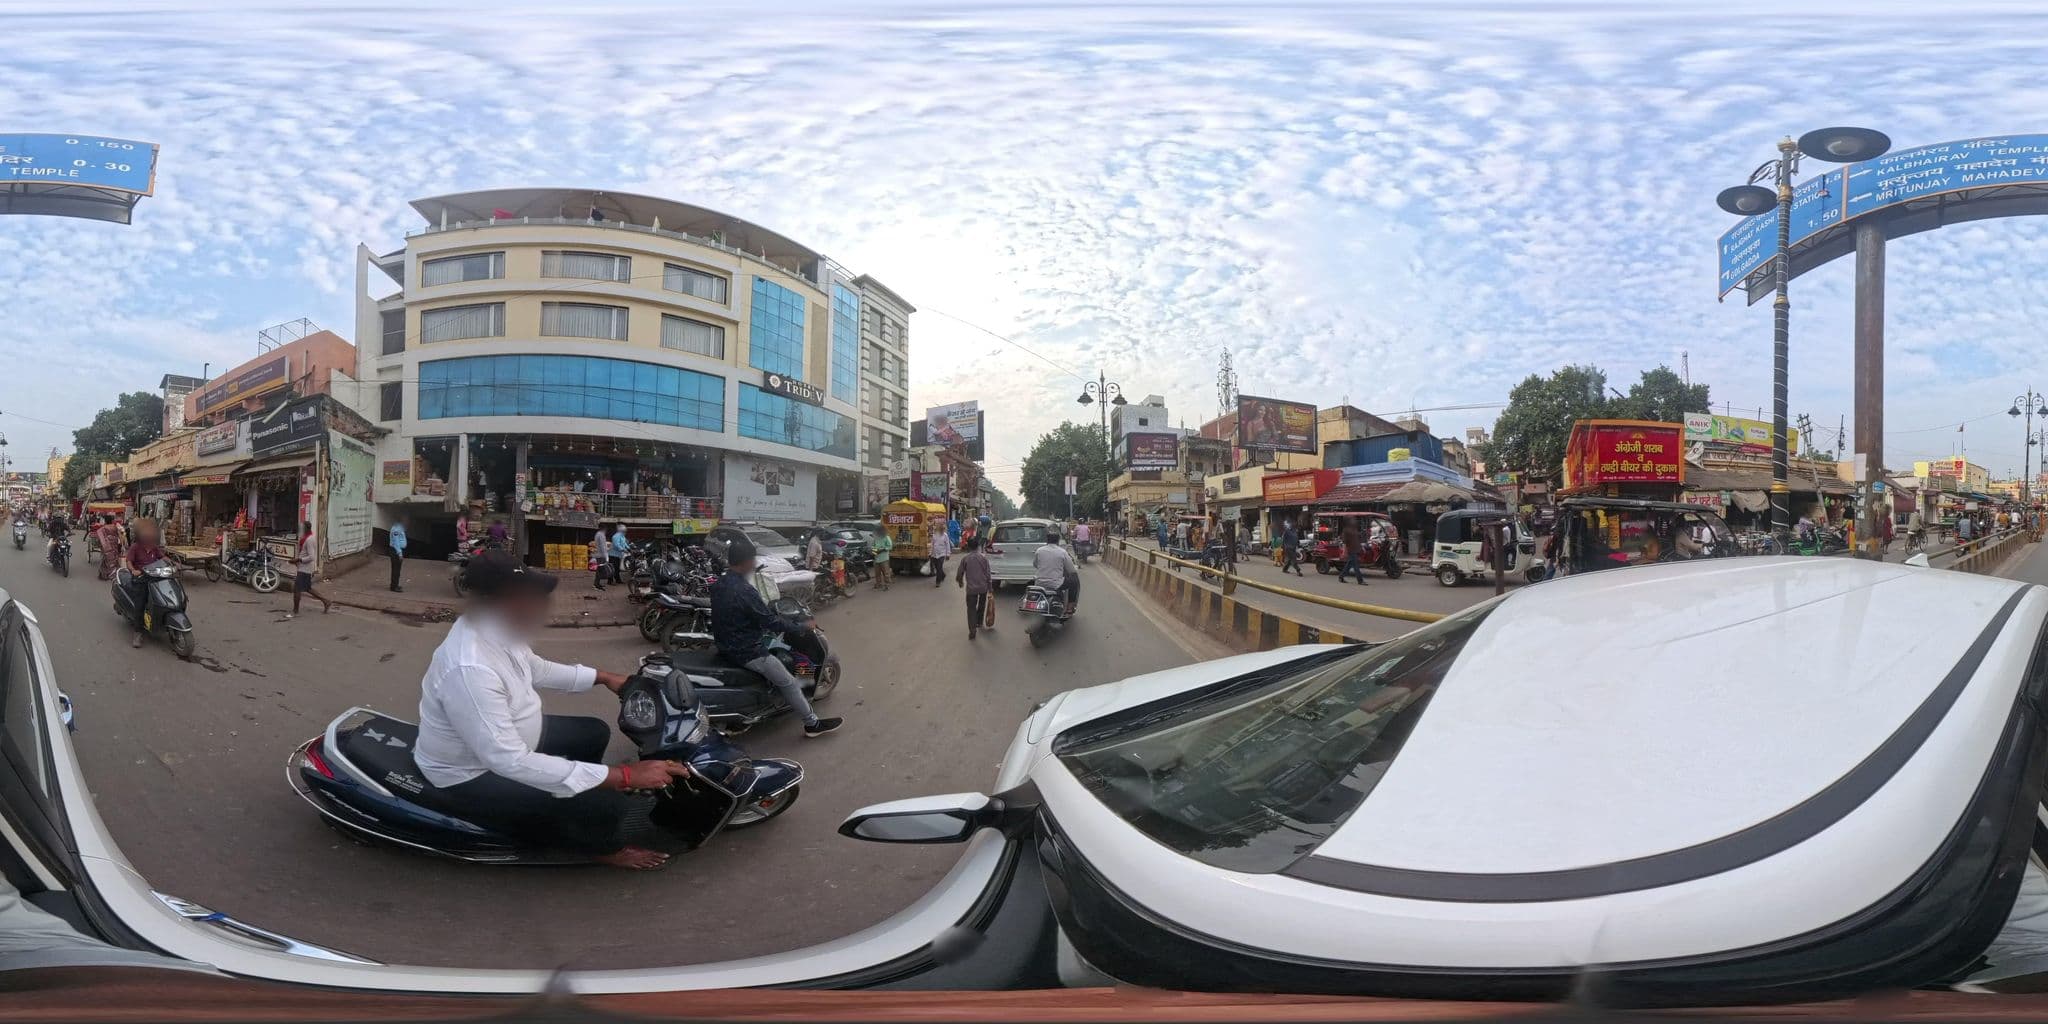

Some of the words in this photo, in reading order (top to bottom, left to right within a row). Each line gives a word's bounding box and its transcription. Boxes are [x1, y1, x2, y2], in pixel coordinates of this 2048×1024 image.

[10, 167, 80, 177] TEMPLE
[1877, 152, 1970, 176] KALBHAIRAV
[1954, 157, 2017, 171] महादेव
[1876, 177, 1951, 202] MRITUNJAY
[1962, 168, 2047, 182] MAHADEV
[1756, 216, 1775, 232] KASHI
[784, 380, 823, 402] TRIDEV
[253, 422, 289, 440] Panasonic
[1689, 420, 1710, 428] ANIK
[1642, 461, 1653, 473] की
[1655, 463, 1677, 475] दुकान
